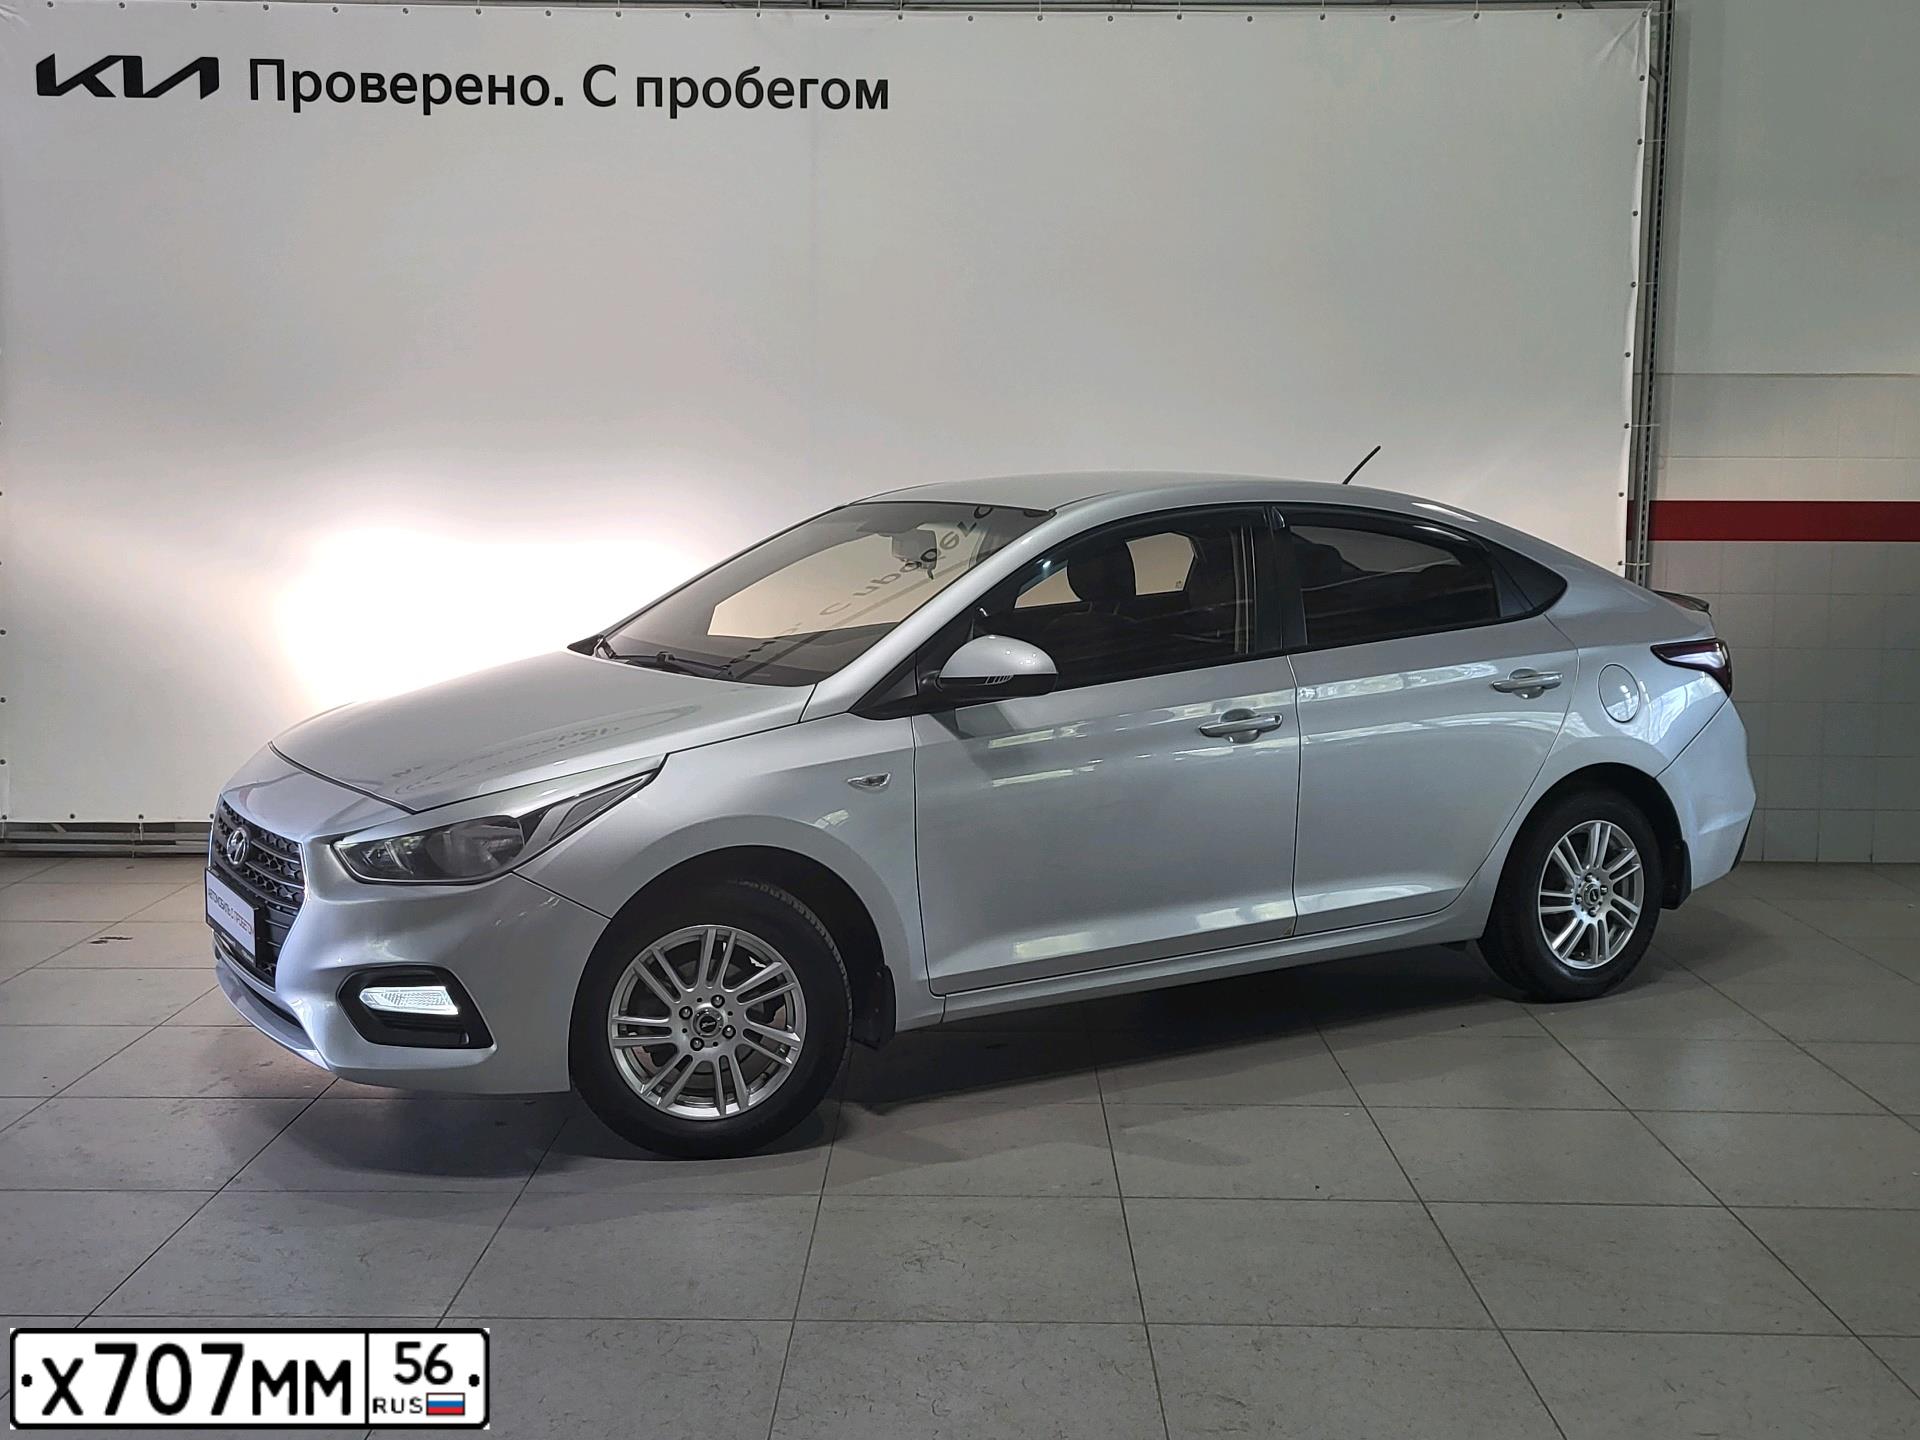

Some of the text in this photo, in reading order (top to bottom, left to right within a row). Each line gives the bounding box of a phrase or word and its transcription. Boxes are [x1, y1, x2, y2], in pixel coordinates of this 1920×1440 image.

[250, 58, 889, 119] Проверено. С пробегом
